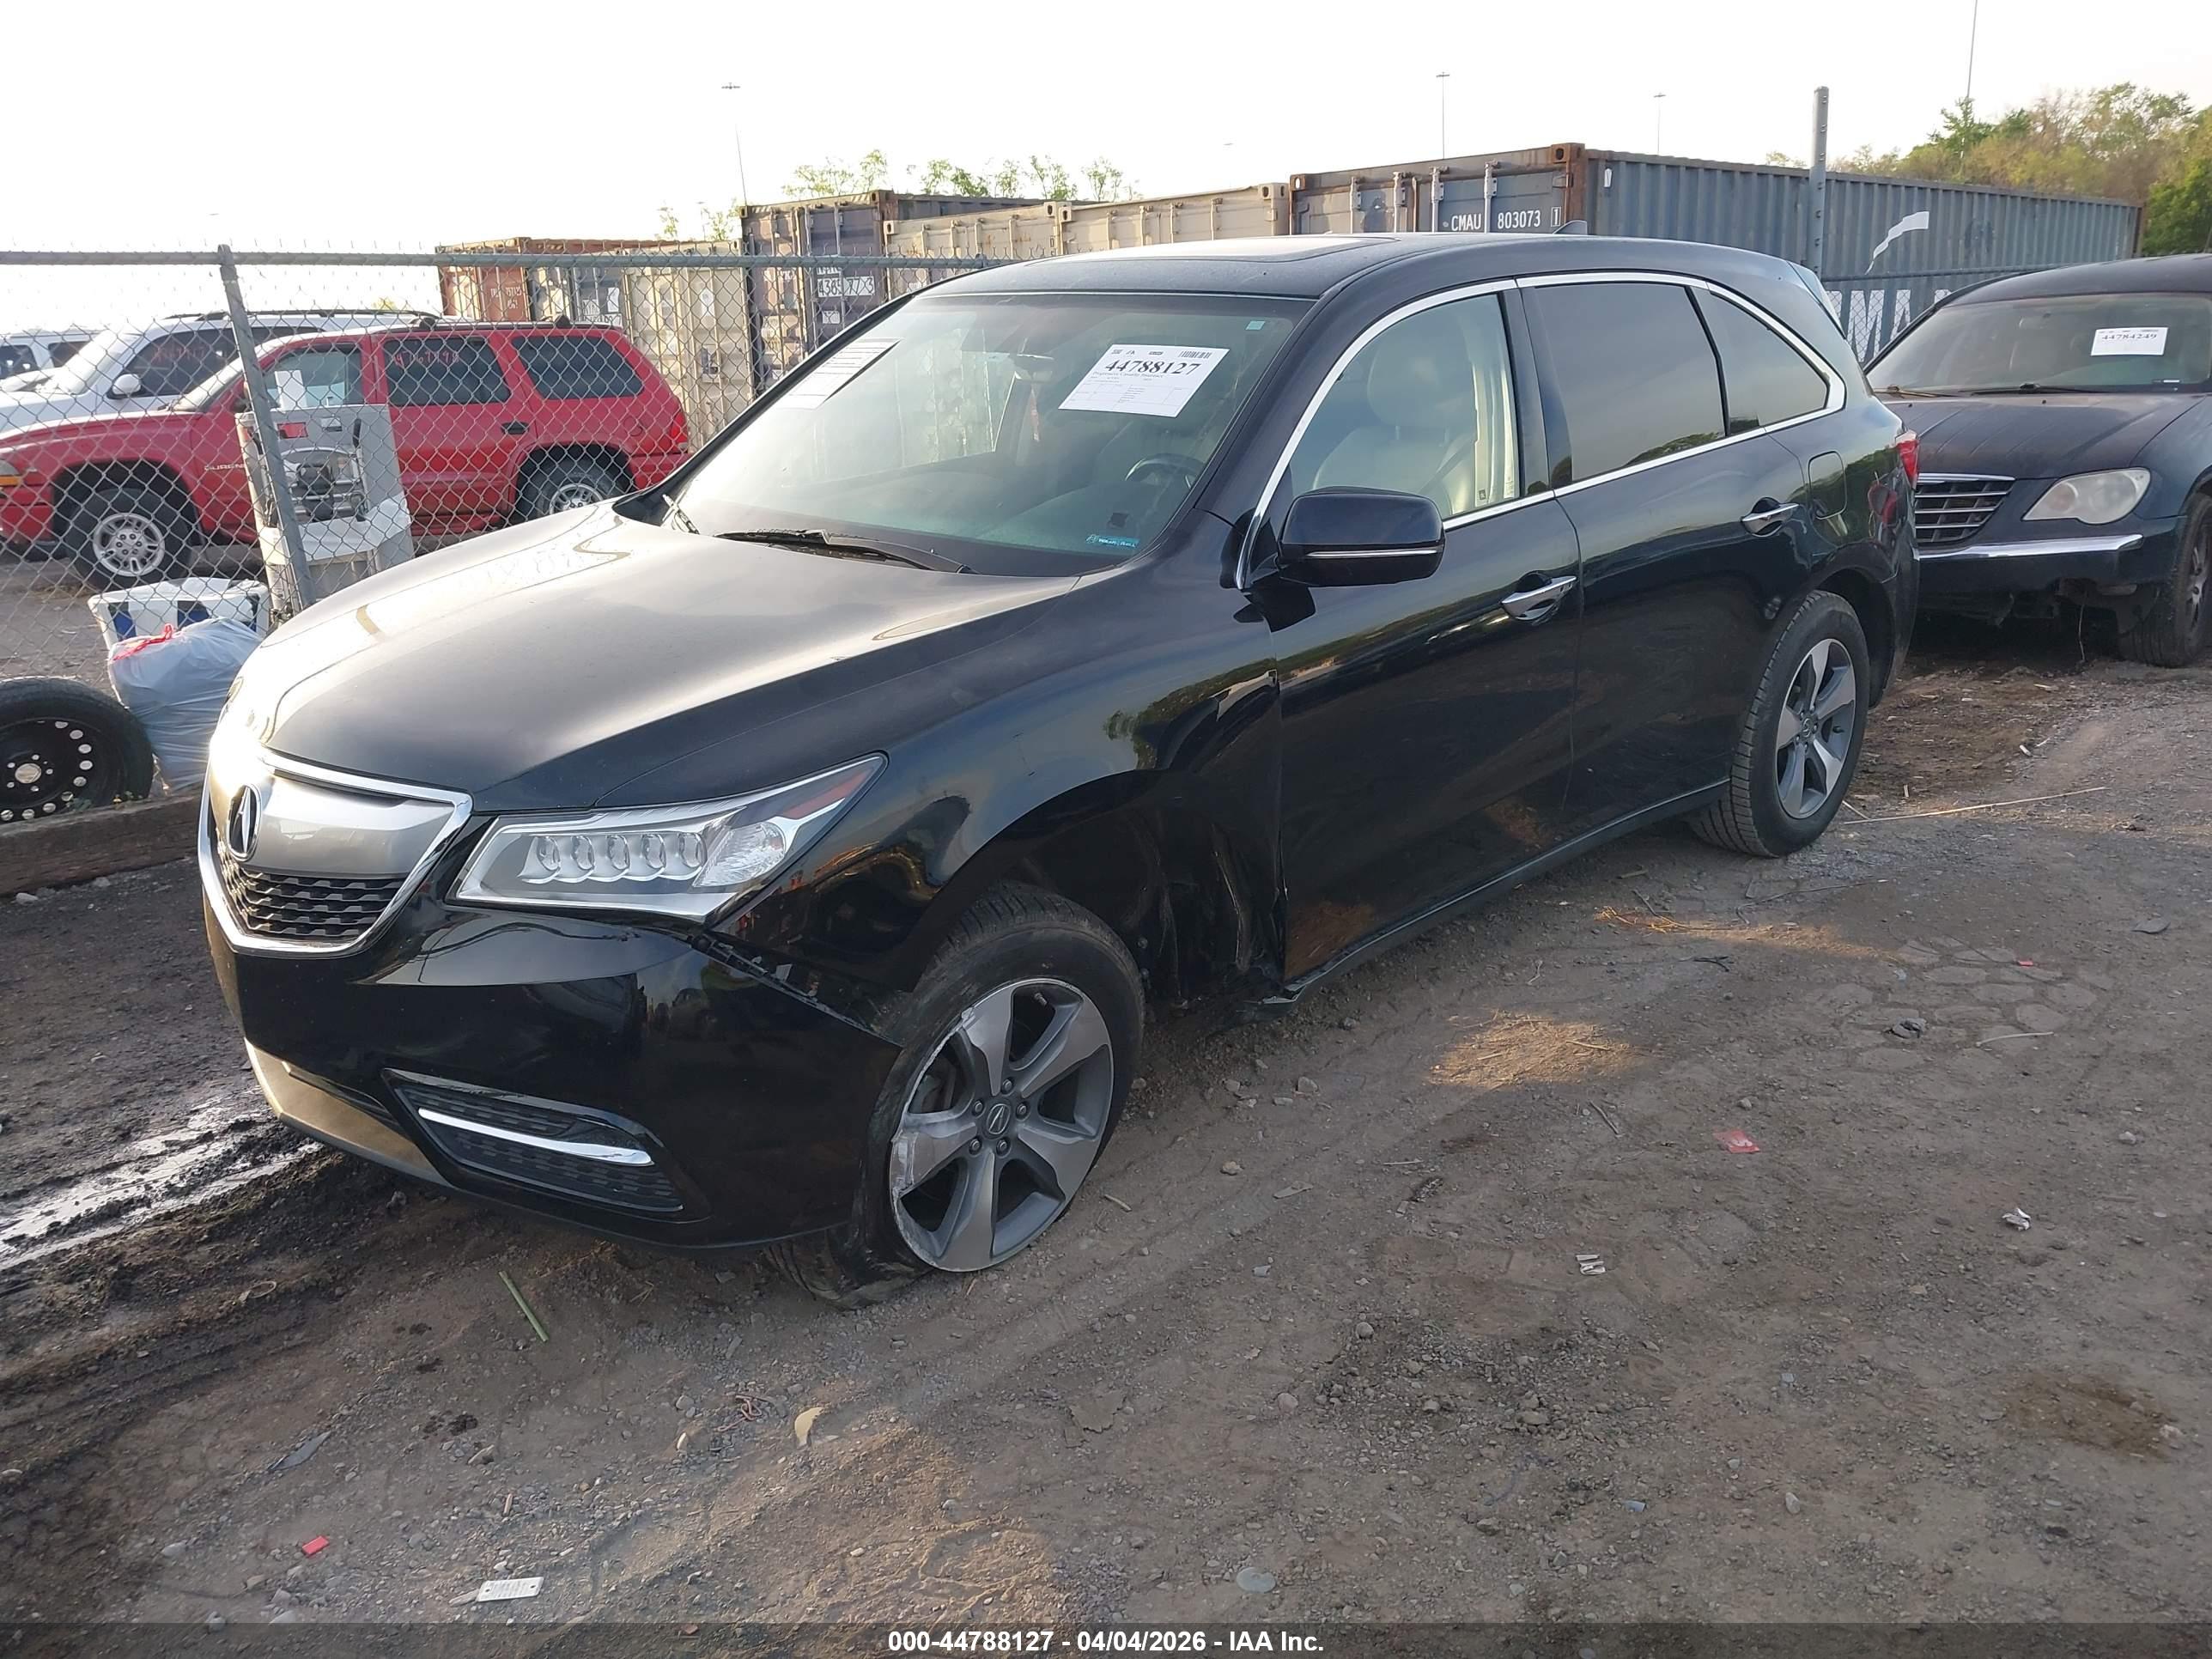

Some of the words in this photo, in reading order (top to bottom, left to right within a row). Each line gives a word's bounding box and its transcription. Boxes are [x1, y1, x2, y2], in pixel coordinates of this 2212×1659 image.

[1451, 213, 1482, 232] CMAU
[1497, 210, 1540, 229] 803073
[1552, 208, 1560, 226] 1
[1105, 359, 1201, 375] 44788127
